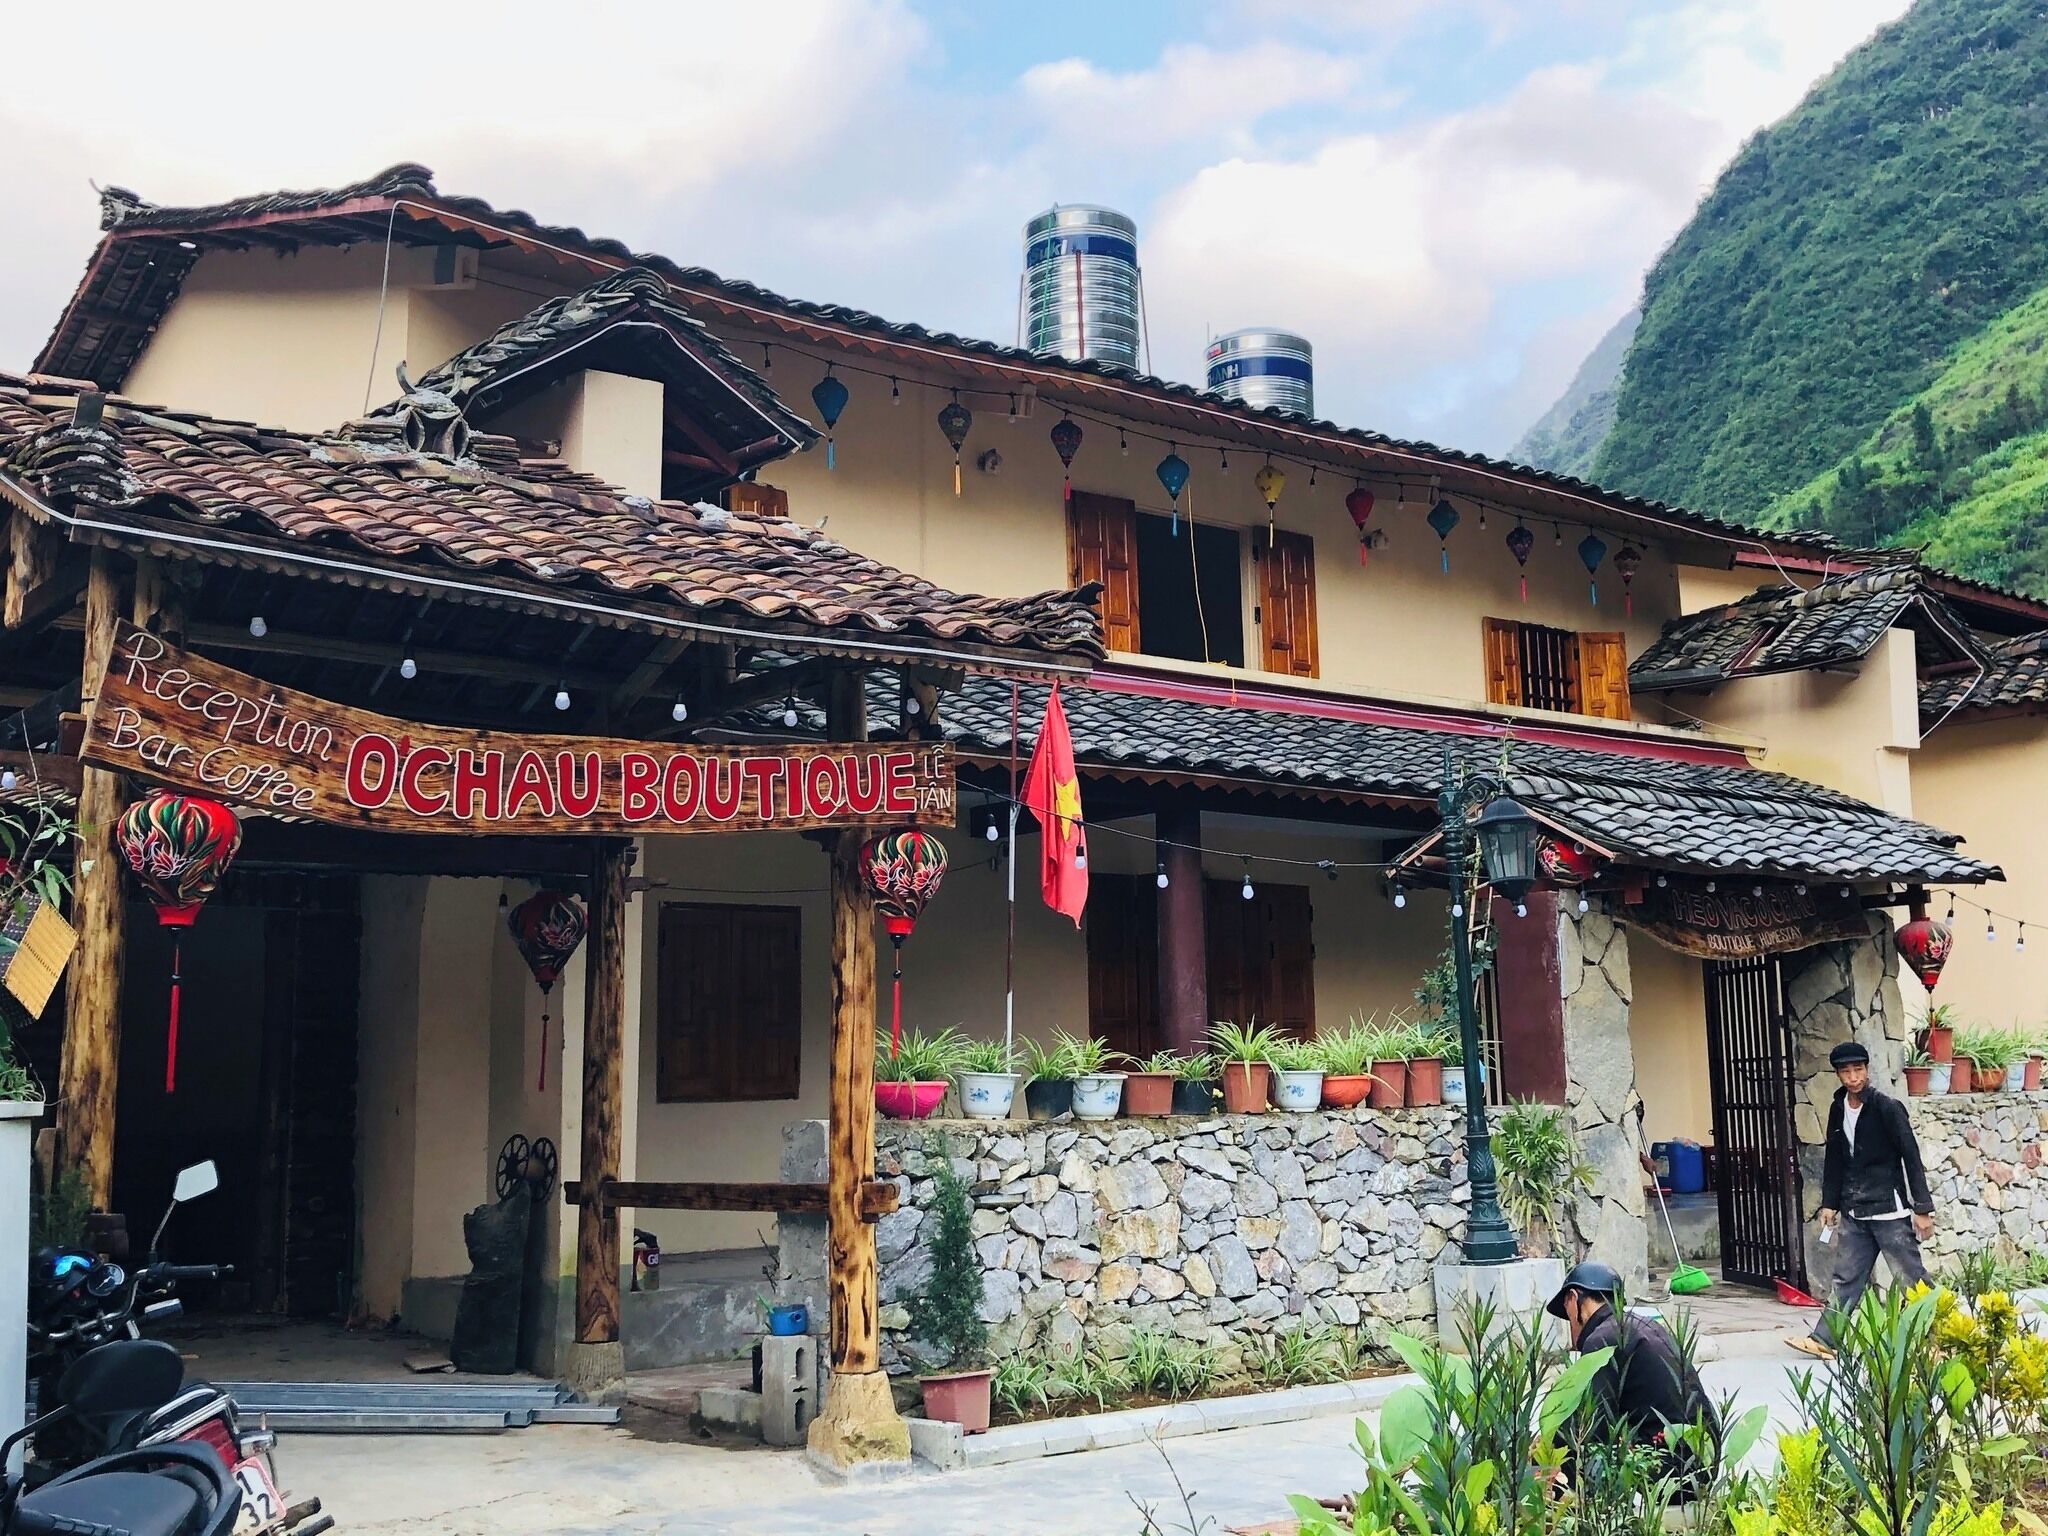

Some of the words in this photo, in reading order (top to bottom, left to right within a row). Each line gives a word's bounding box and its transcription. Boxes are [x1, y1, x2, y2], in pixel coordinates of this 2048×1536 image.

[125, 631, 333, 762] Reception
[345, 733, 602, 820] O'CHAU
[621, 752, 918, 824] BOUTIQUE
[923, 742, 947, 779] LỄ
[915, 781, 952, 811] TÂN
[1706, 933, 1756, 952] BOUTIQUE
[1758, 926, 1803, 950] HOMESTAY
